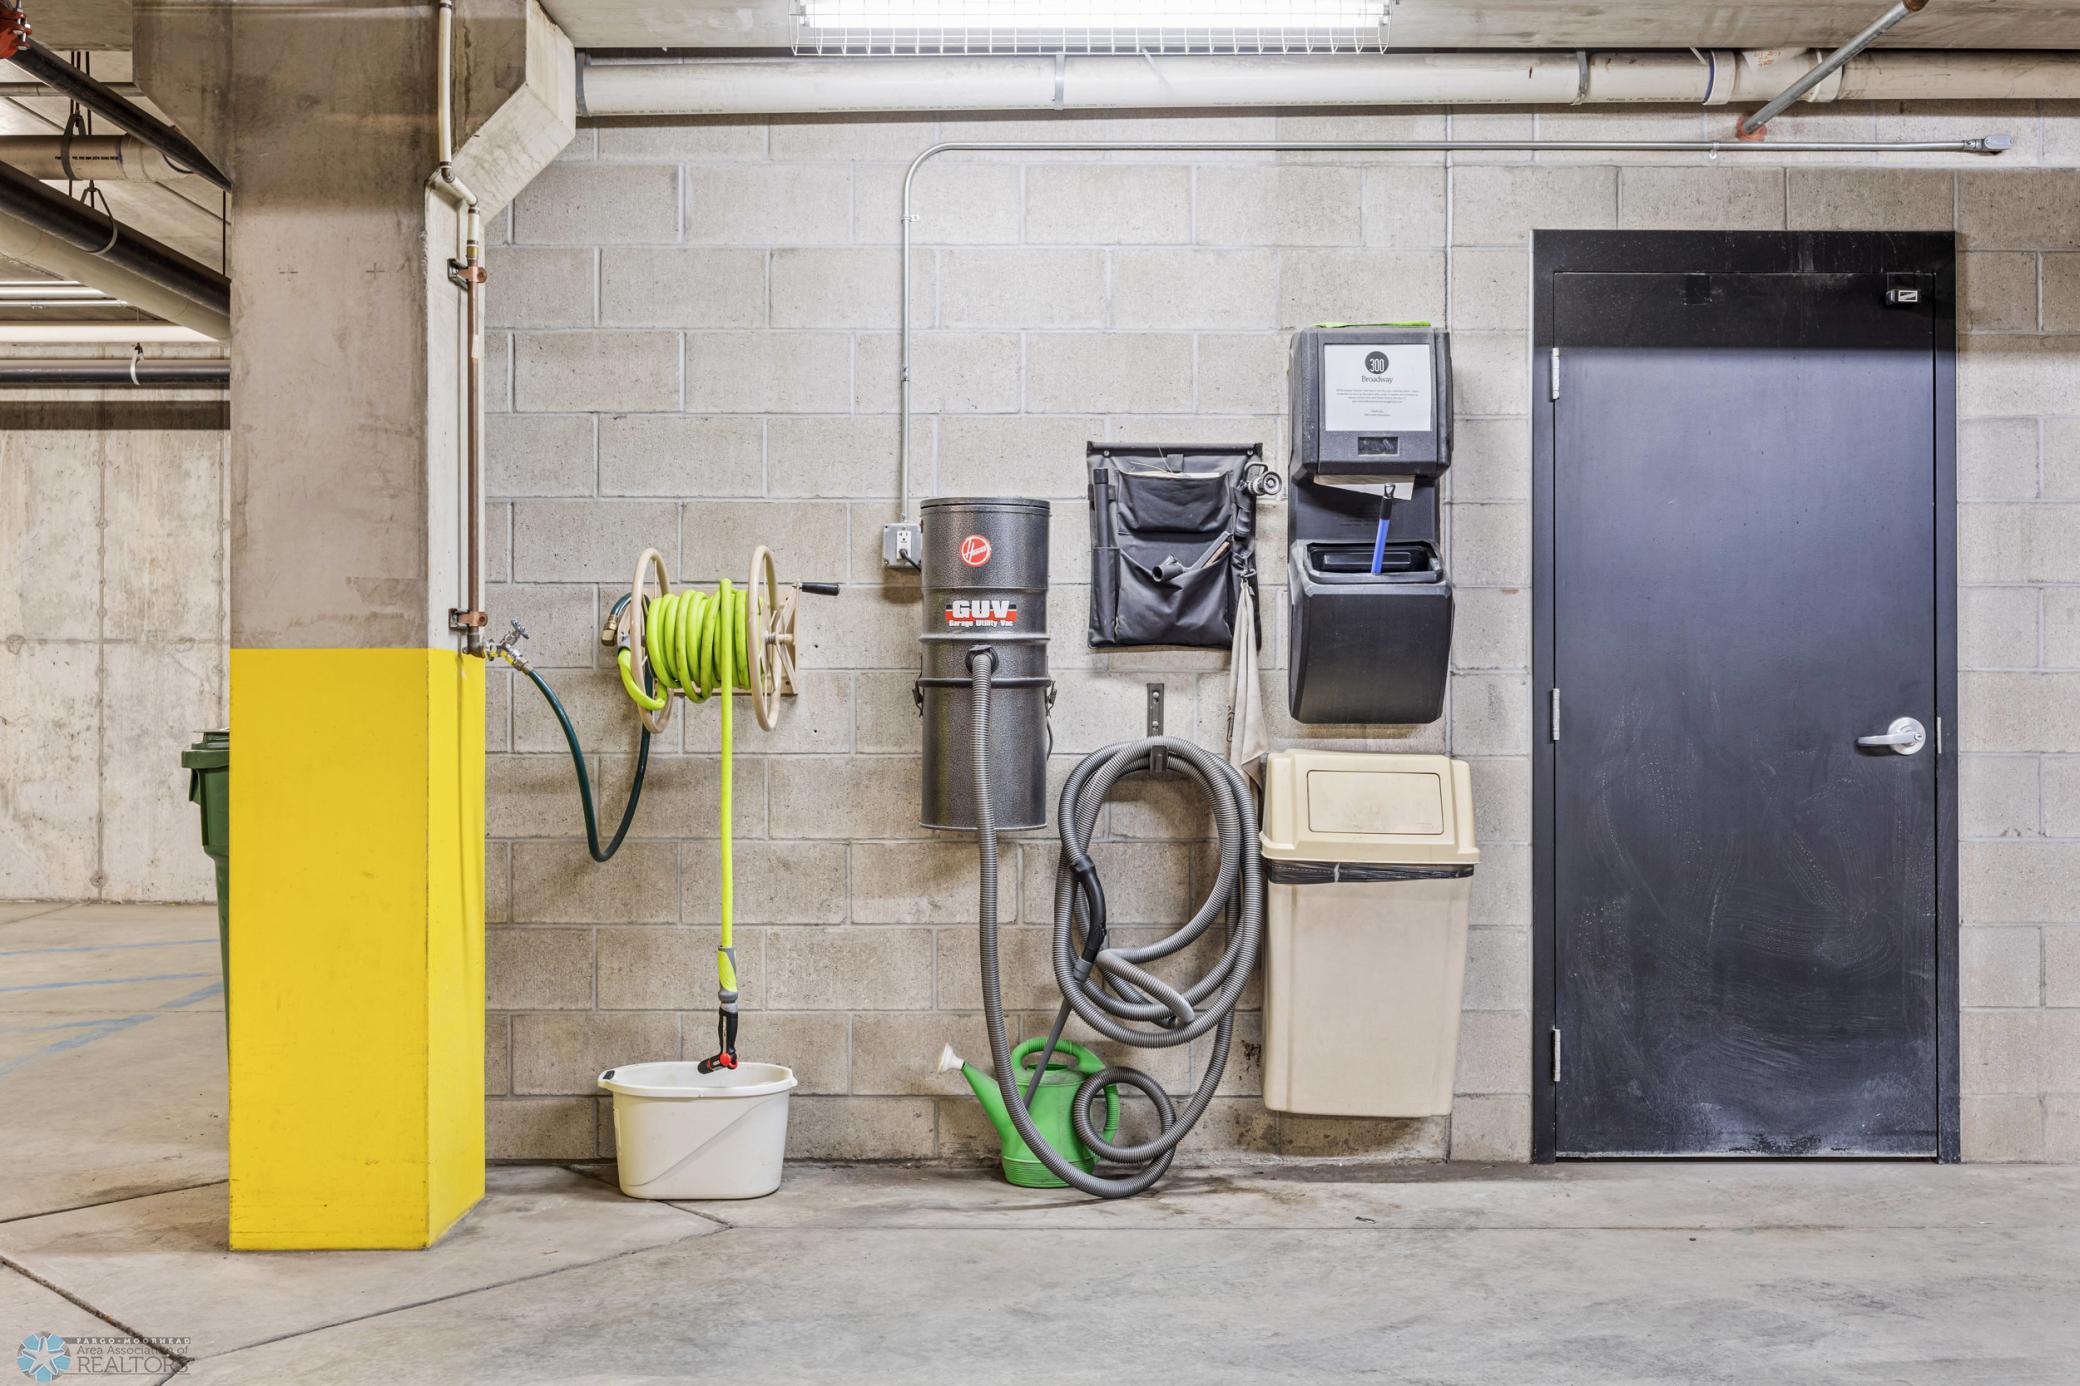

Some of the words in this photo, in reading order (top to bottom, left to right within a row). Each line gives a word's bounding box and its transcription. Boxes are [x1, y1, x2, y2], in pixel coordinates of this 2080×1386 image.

[1369, 358, 1385, 372] 300
[1361, 375, 1393, 384] Broadway
[952, 600, 1010, 618] GUV
[975, 619, 998, 628] Utility
